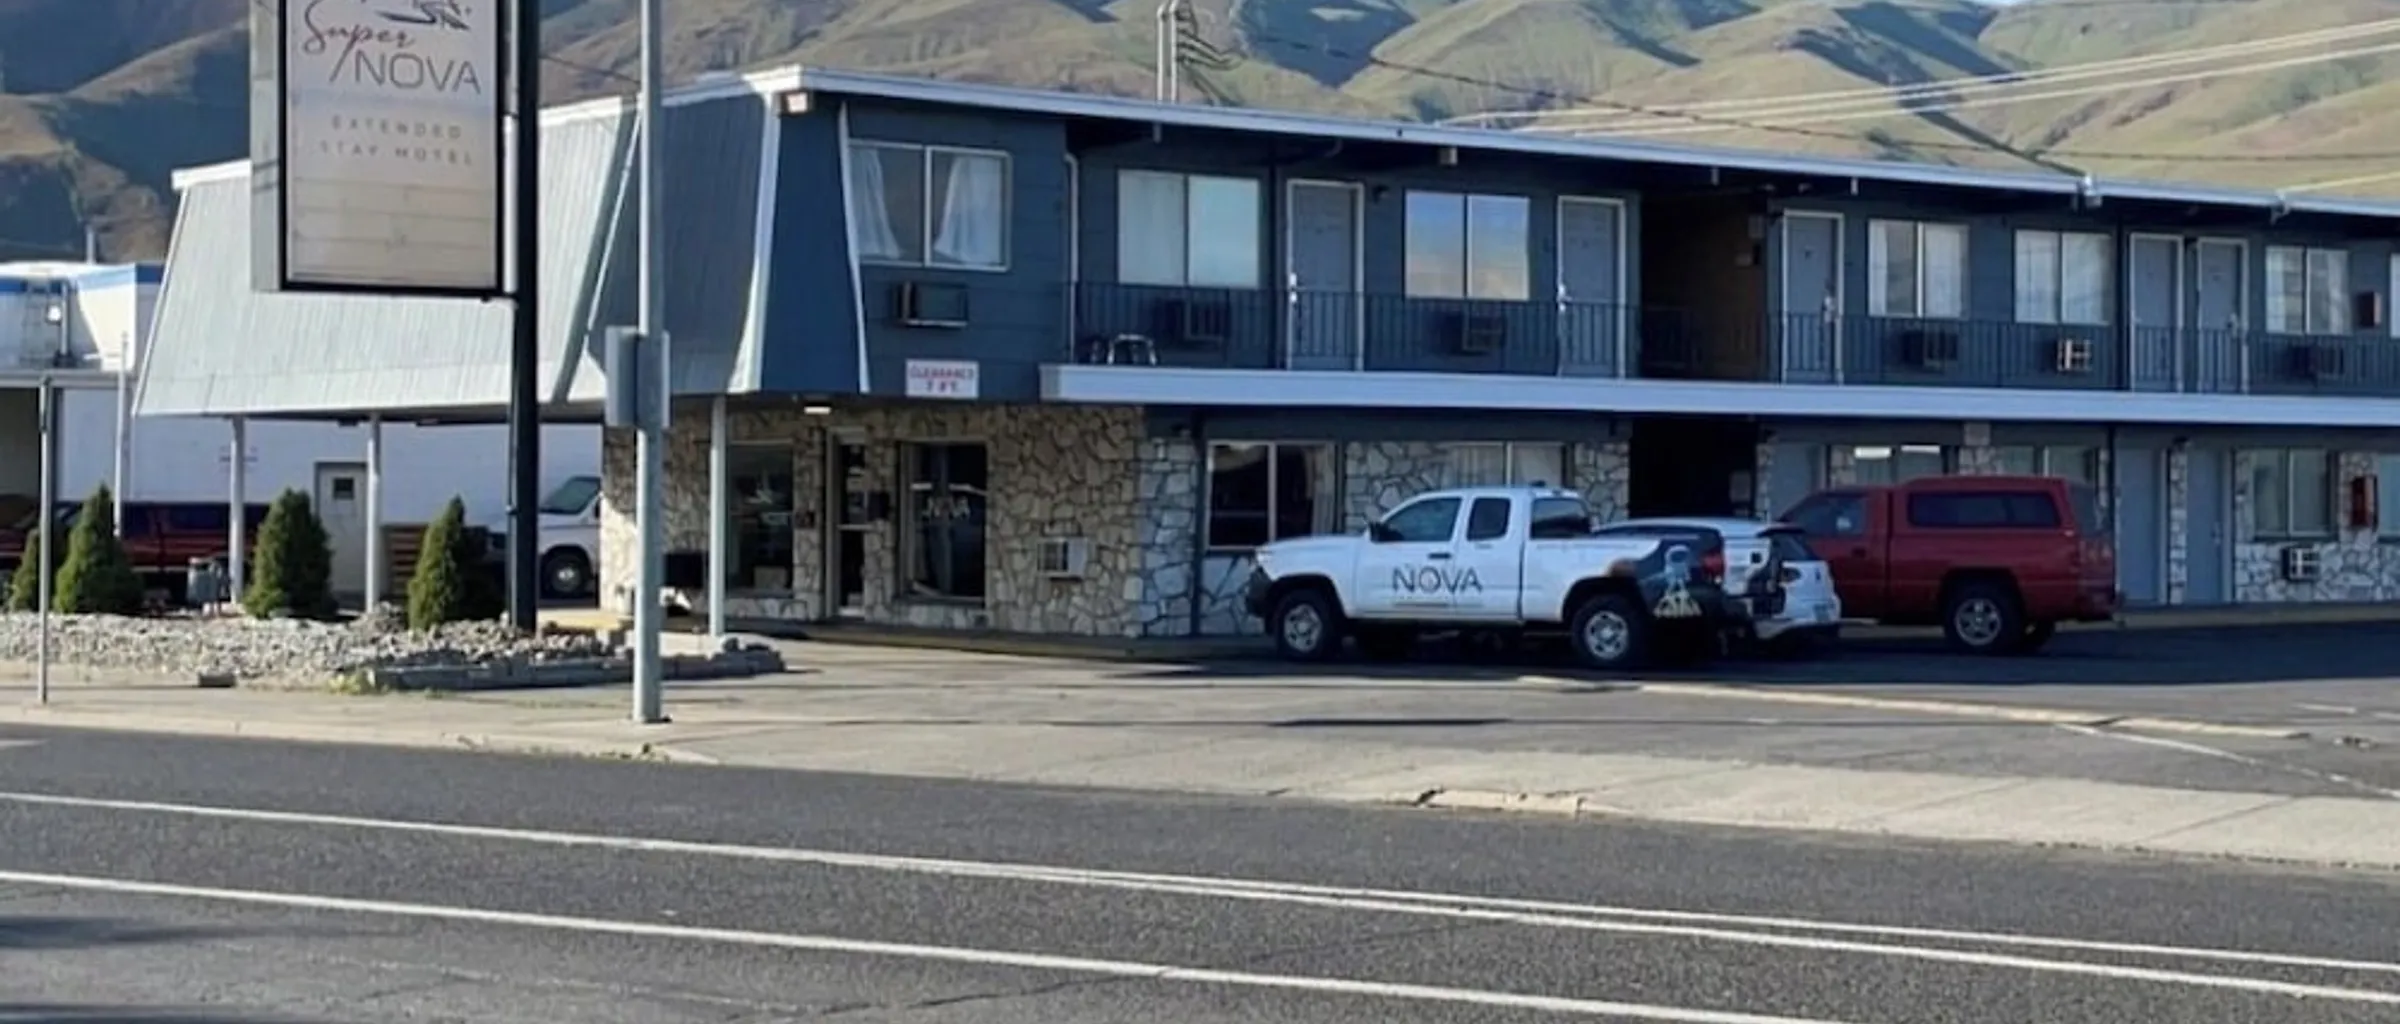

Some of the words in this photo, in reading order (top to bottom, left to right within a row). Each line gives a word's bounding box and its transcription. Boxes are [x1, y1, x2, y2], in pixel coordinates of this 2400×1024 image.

[303, 0, 416, 83] Super
[355, 50, 481, 94] NOVA
[332, 114, 462, 140] EXTENDED
[320, 140, 378, 156] STAY
[395, 147, 472, 167] MOTEL
[1392, 566, 1484, 595] NOVA
